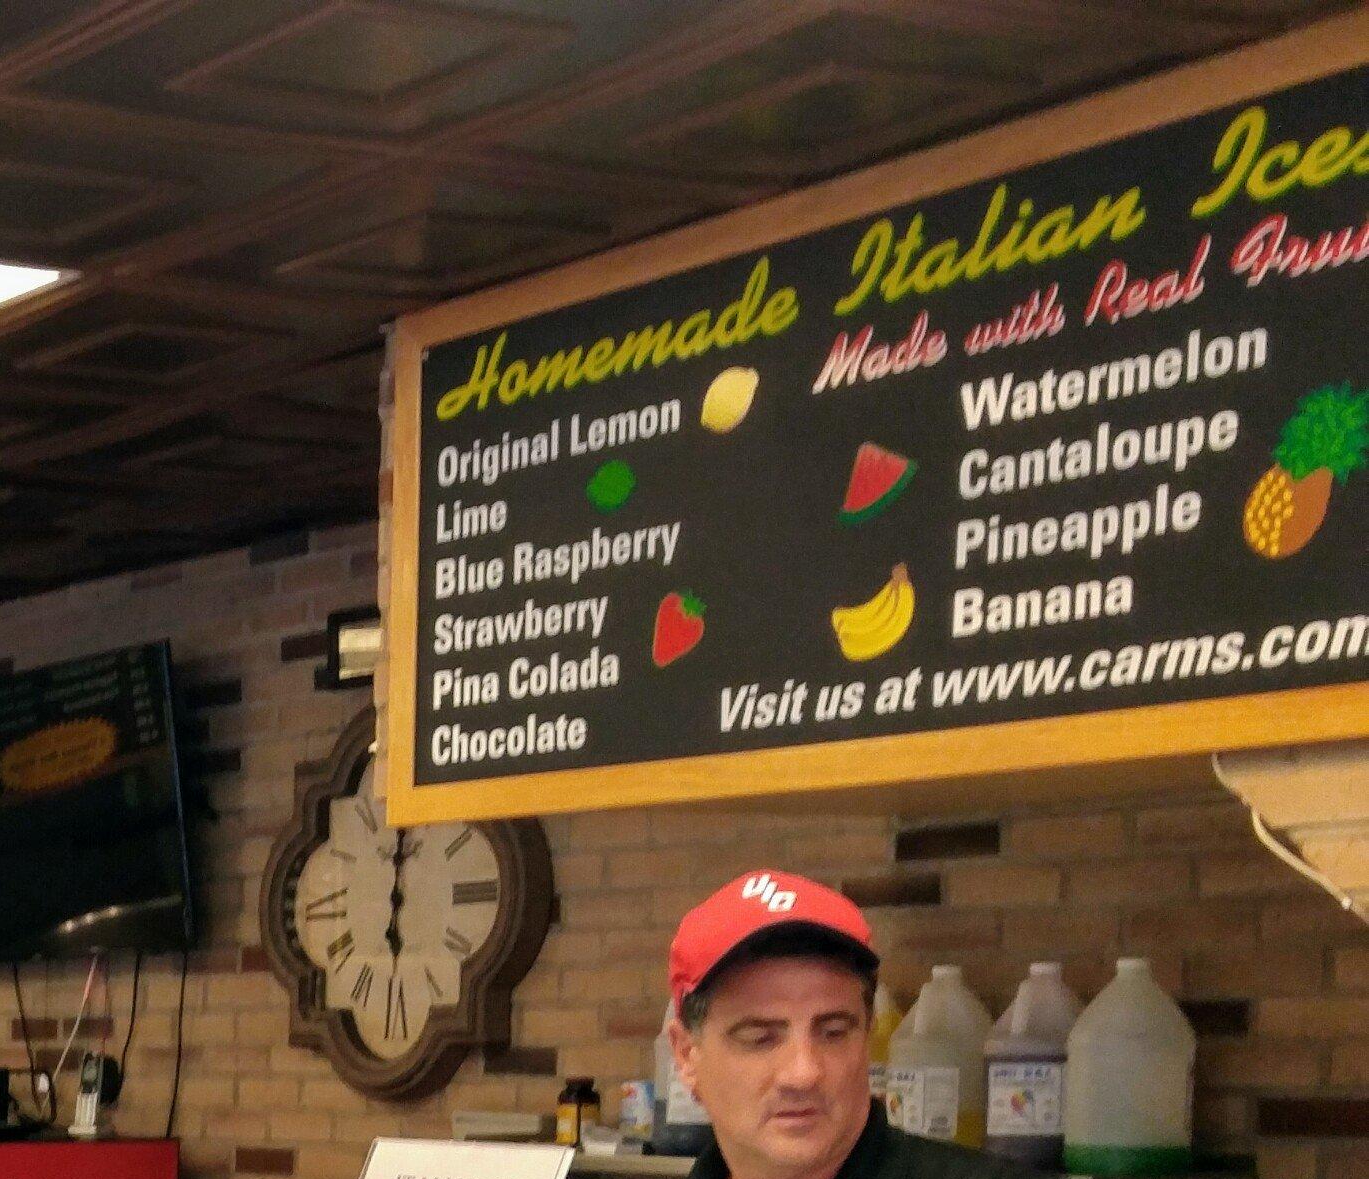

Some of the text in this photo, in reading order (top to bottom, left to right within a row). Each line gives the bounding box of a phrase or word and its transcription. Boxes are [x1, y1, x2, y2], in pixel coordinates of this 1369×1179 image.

[436, 254, 799, 422] Homemade
[833, 182, 1147, 316] Italian
[811, 212, 1369, 396] Made with Real Fru
[961, 326, 1269, 430] Watermelon
[437, 399, 681, 487] Original Lemon
[958, 408, 1239, 499] Cantaloupe
[435, 521, 681, 599] Blue Raspberry
[436, 499, 508, 544] Lime
[954, 486, 1202, 568] Pineapple
[434, 596, 609, 655] Strawberry
[950, 574, 1135, 638] Banana
[433, 646, 621, 711] Pina Colada
[720, 618, 1369, 731] Visit us at www.carms.com
[431, 713, 588, 766] Chocolate
